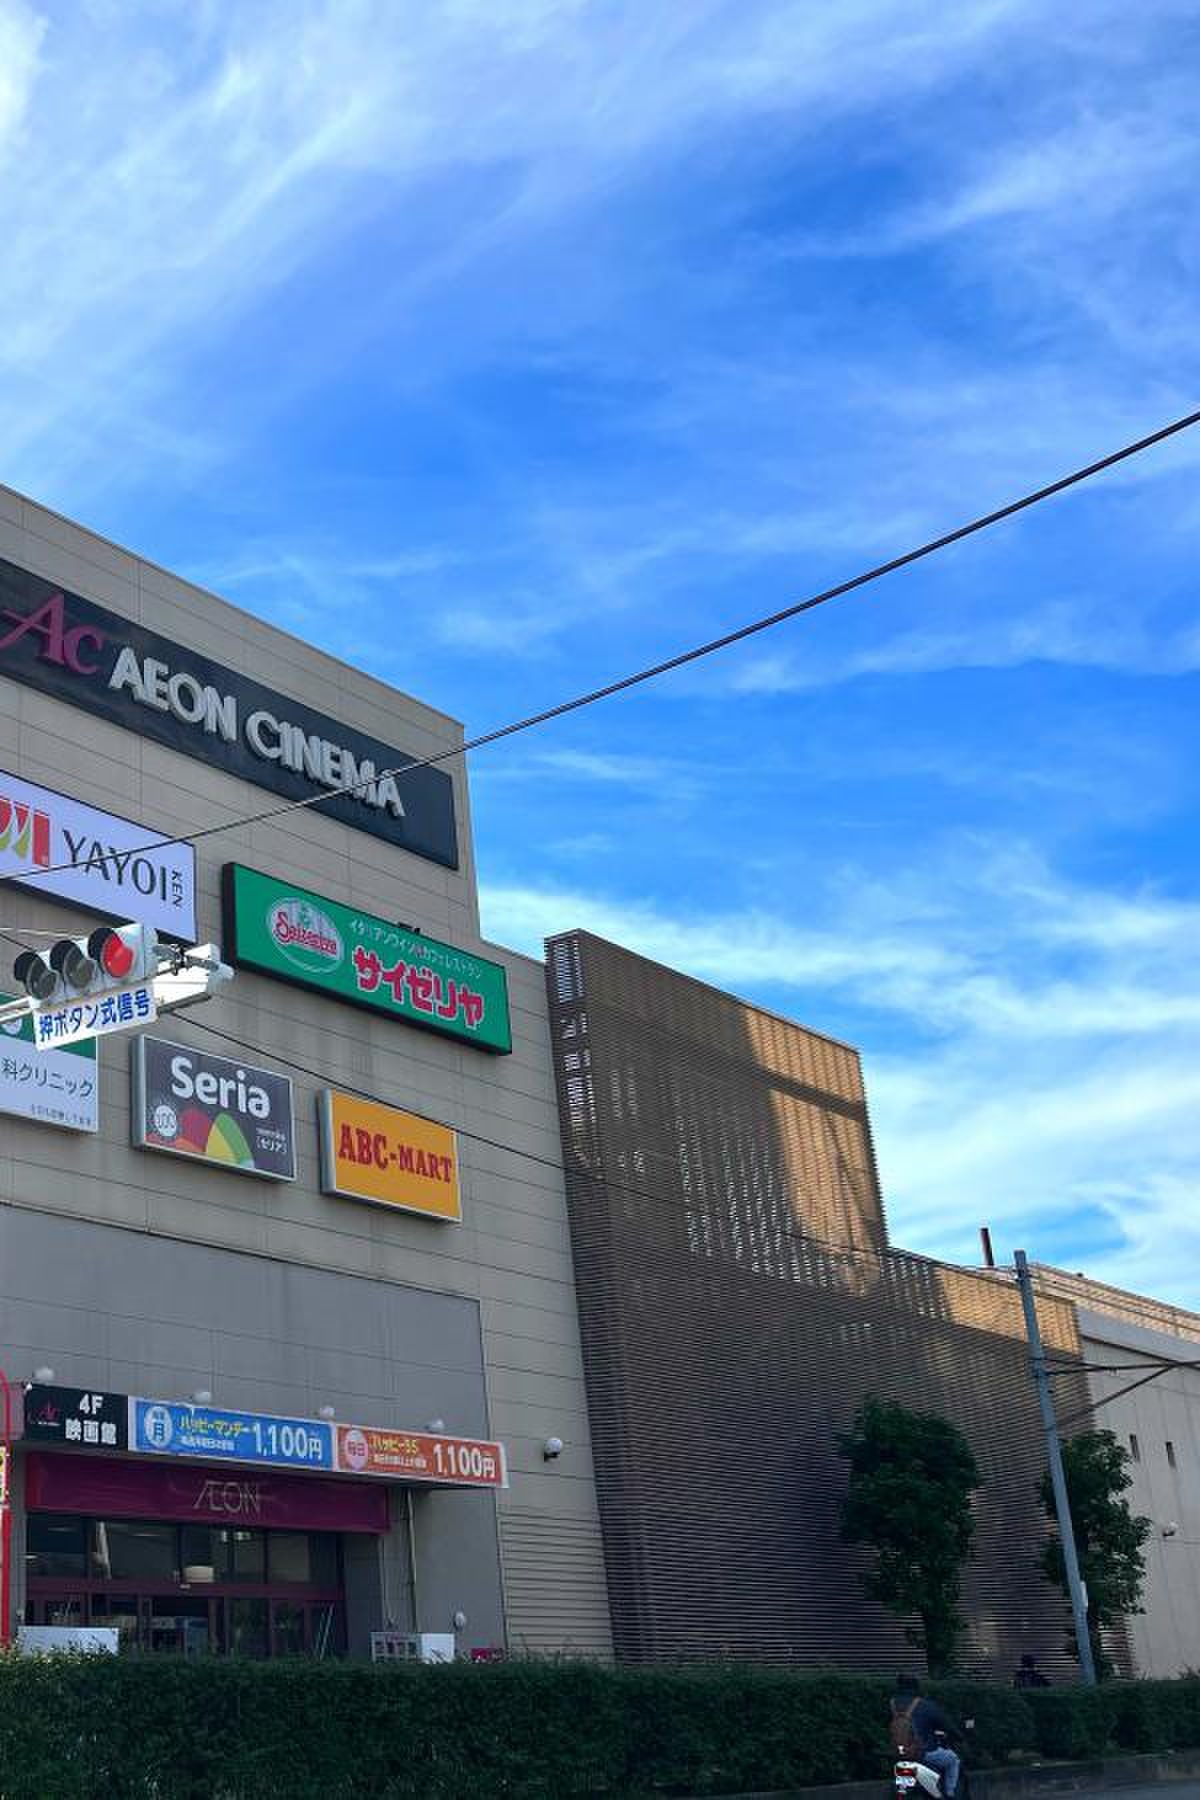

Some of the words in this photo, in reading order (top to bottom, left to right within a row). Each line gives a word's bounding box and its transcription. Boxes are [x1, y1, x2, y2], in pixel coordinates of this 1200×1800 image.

[109, 646, 237, 742] AEON
[246, 711, 406, 817] CINEMA
[63, 829, 168, 900] YAYOI
[171, 869, 182, 908] KEN
[39, 988, 150, 1042] 押ボタン式信号
[352, 944, 484, 1030] サイゼリヤ
[171, 1056, 270, 1119] Seria
[338, 1123, 452, 1183] ABC-MART
[65, 1418, 117, 1445] 映画館
[79, 1393, 103, 1415] 4F
